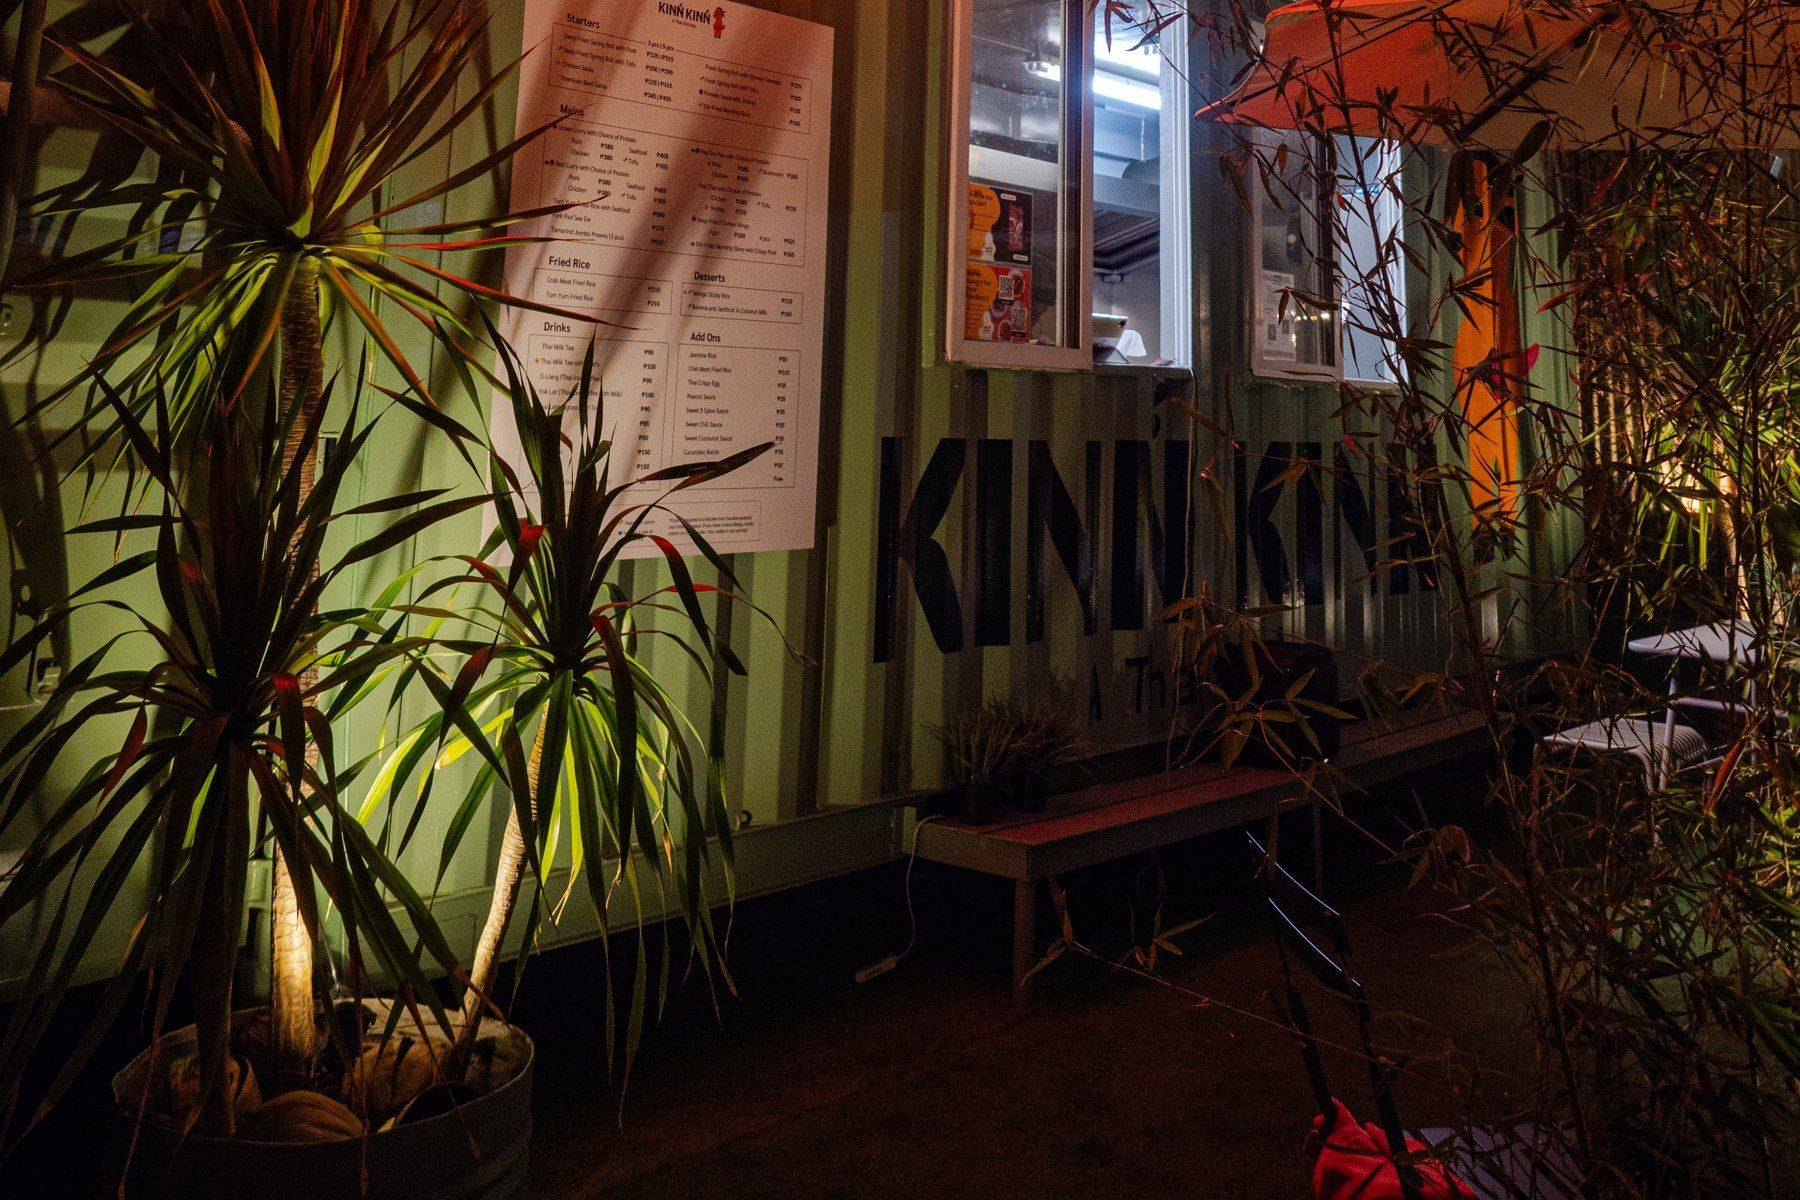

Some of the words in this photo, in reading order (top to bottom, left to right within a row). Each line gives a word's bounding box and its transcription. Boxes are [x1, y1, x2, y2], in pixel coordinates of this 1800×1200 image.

[567, 13, 599, 29] Starters
[560, 104, 584, 117] Mains
[549, 256, 571, 267] Fried
[573, 259, 590, 269] Rice
[694, 270, 726, 283] Desserts
[544, 322, 570, 332] Drinks
[690, 332, 705, 341] Add
[707, 333, 721, 342] Ons
